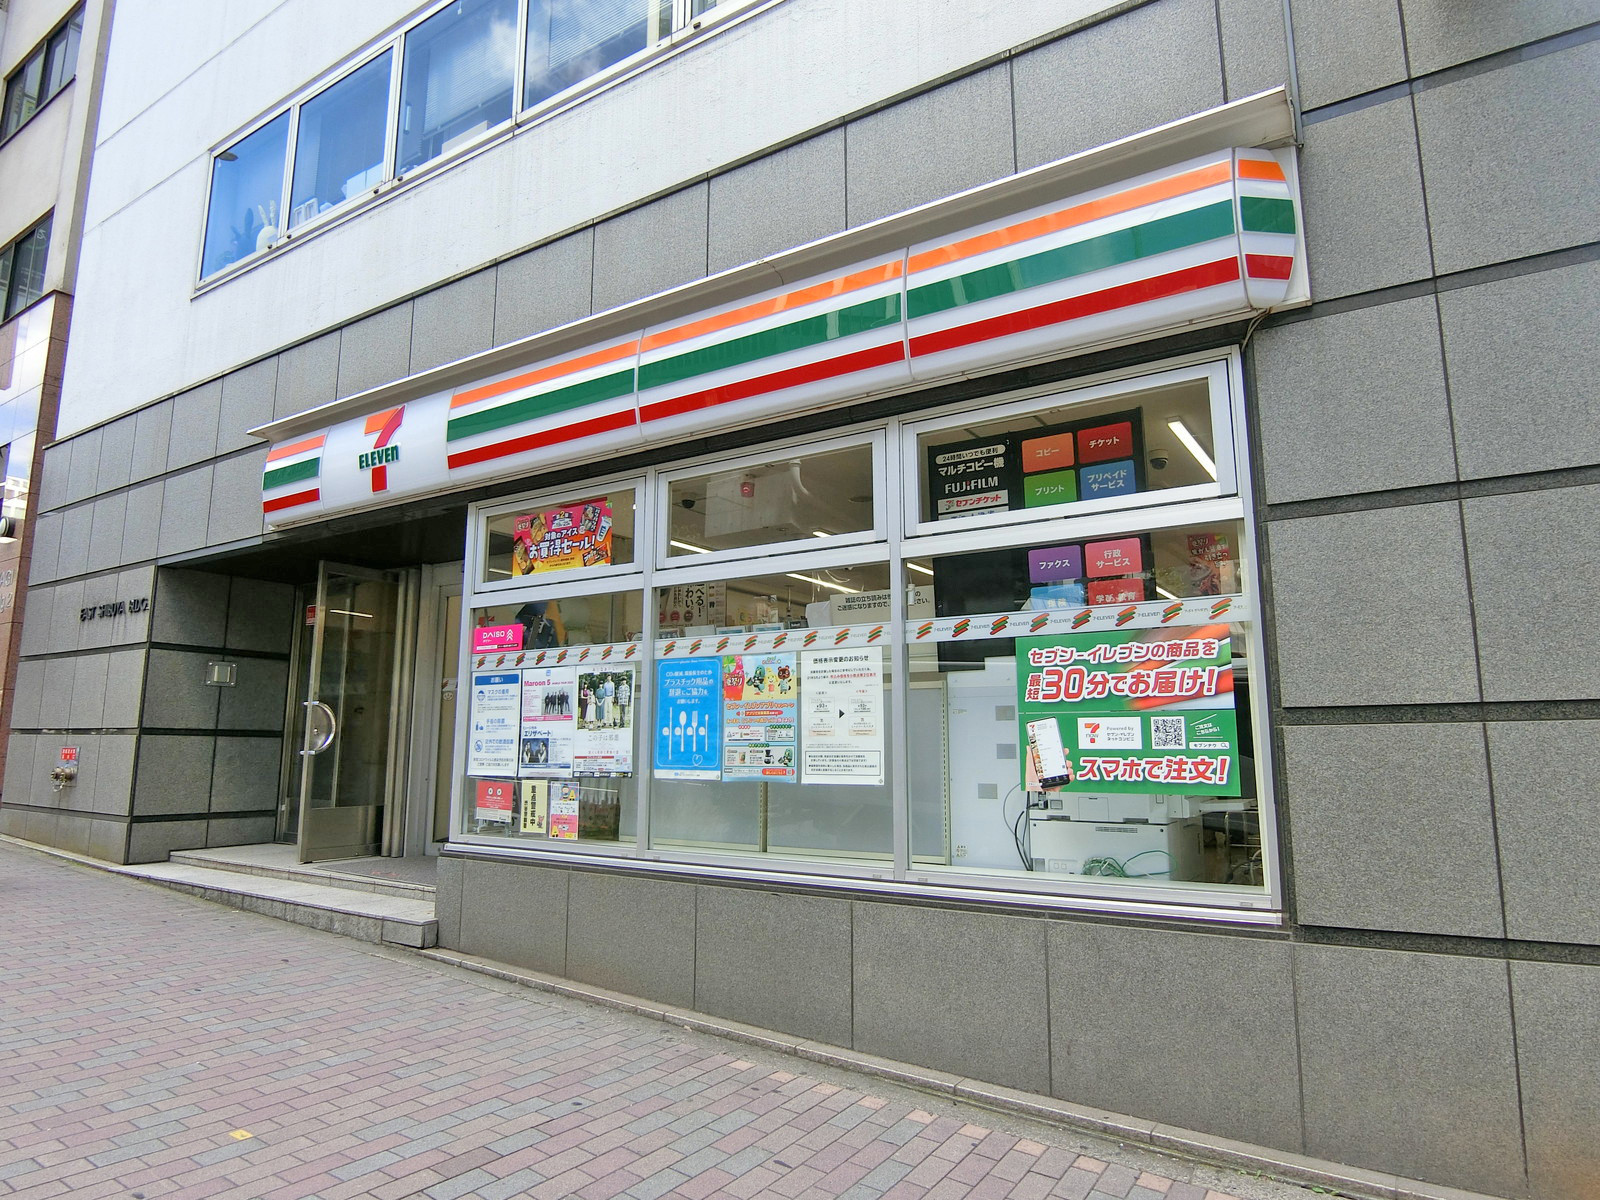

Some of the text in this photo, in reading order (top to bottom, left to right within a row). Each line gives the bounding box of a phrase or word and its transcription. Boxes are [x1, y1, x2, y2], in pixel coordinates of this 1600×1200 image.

[1089, 436, 1120, 448] チケット
[364, 405, 405, 492] 7
[1036, 448, 1059, 457] コピー
[942, 447, 999, 462] 24時間いつでも便利
[938, 457, 1005, 476] マルチコピー機
[1088, 469, 1127, 482] プリペイド
[1035, 485, 1065, 495] プリント
[1091, 480, 1125, 491] サービス
[956, 494, 1002, 507] セブンチケット
[545, 528, 578, 541] 対象のアイス
[529, 535, 595, 559] お買得セール!
[1104, 549, 1121, 558] 行政
[1039, 559, 1071, 569] ファクス
[1096, 558, 1130, 568] サービス
[483, 631, 505, 639] DAISO
[813, 655, 869, 664] 価格表示変更のお知らせ
[664, 678, 714, 687] プラスチック用品の
[1079, 758, 1229, 783] スマホで注文!
